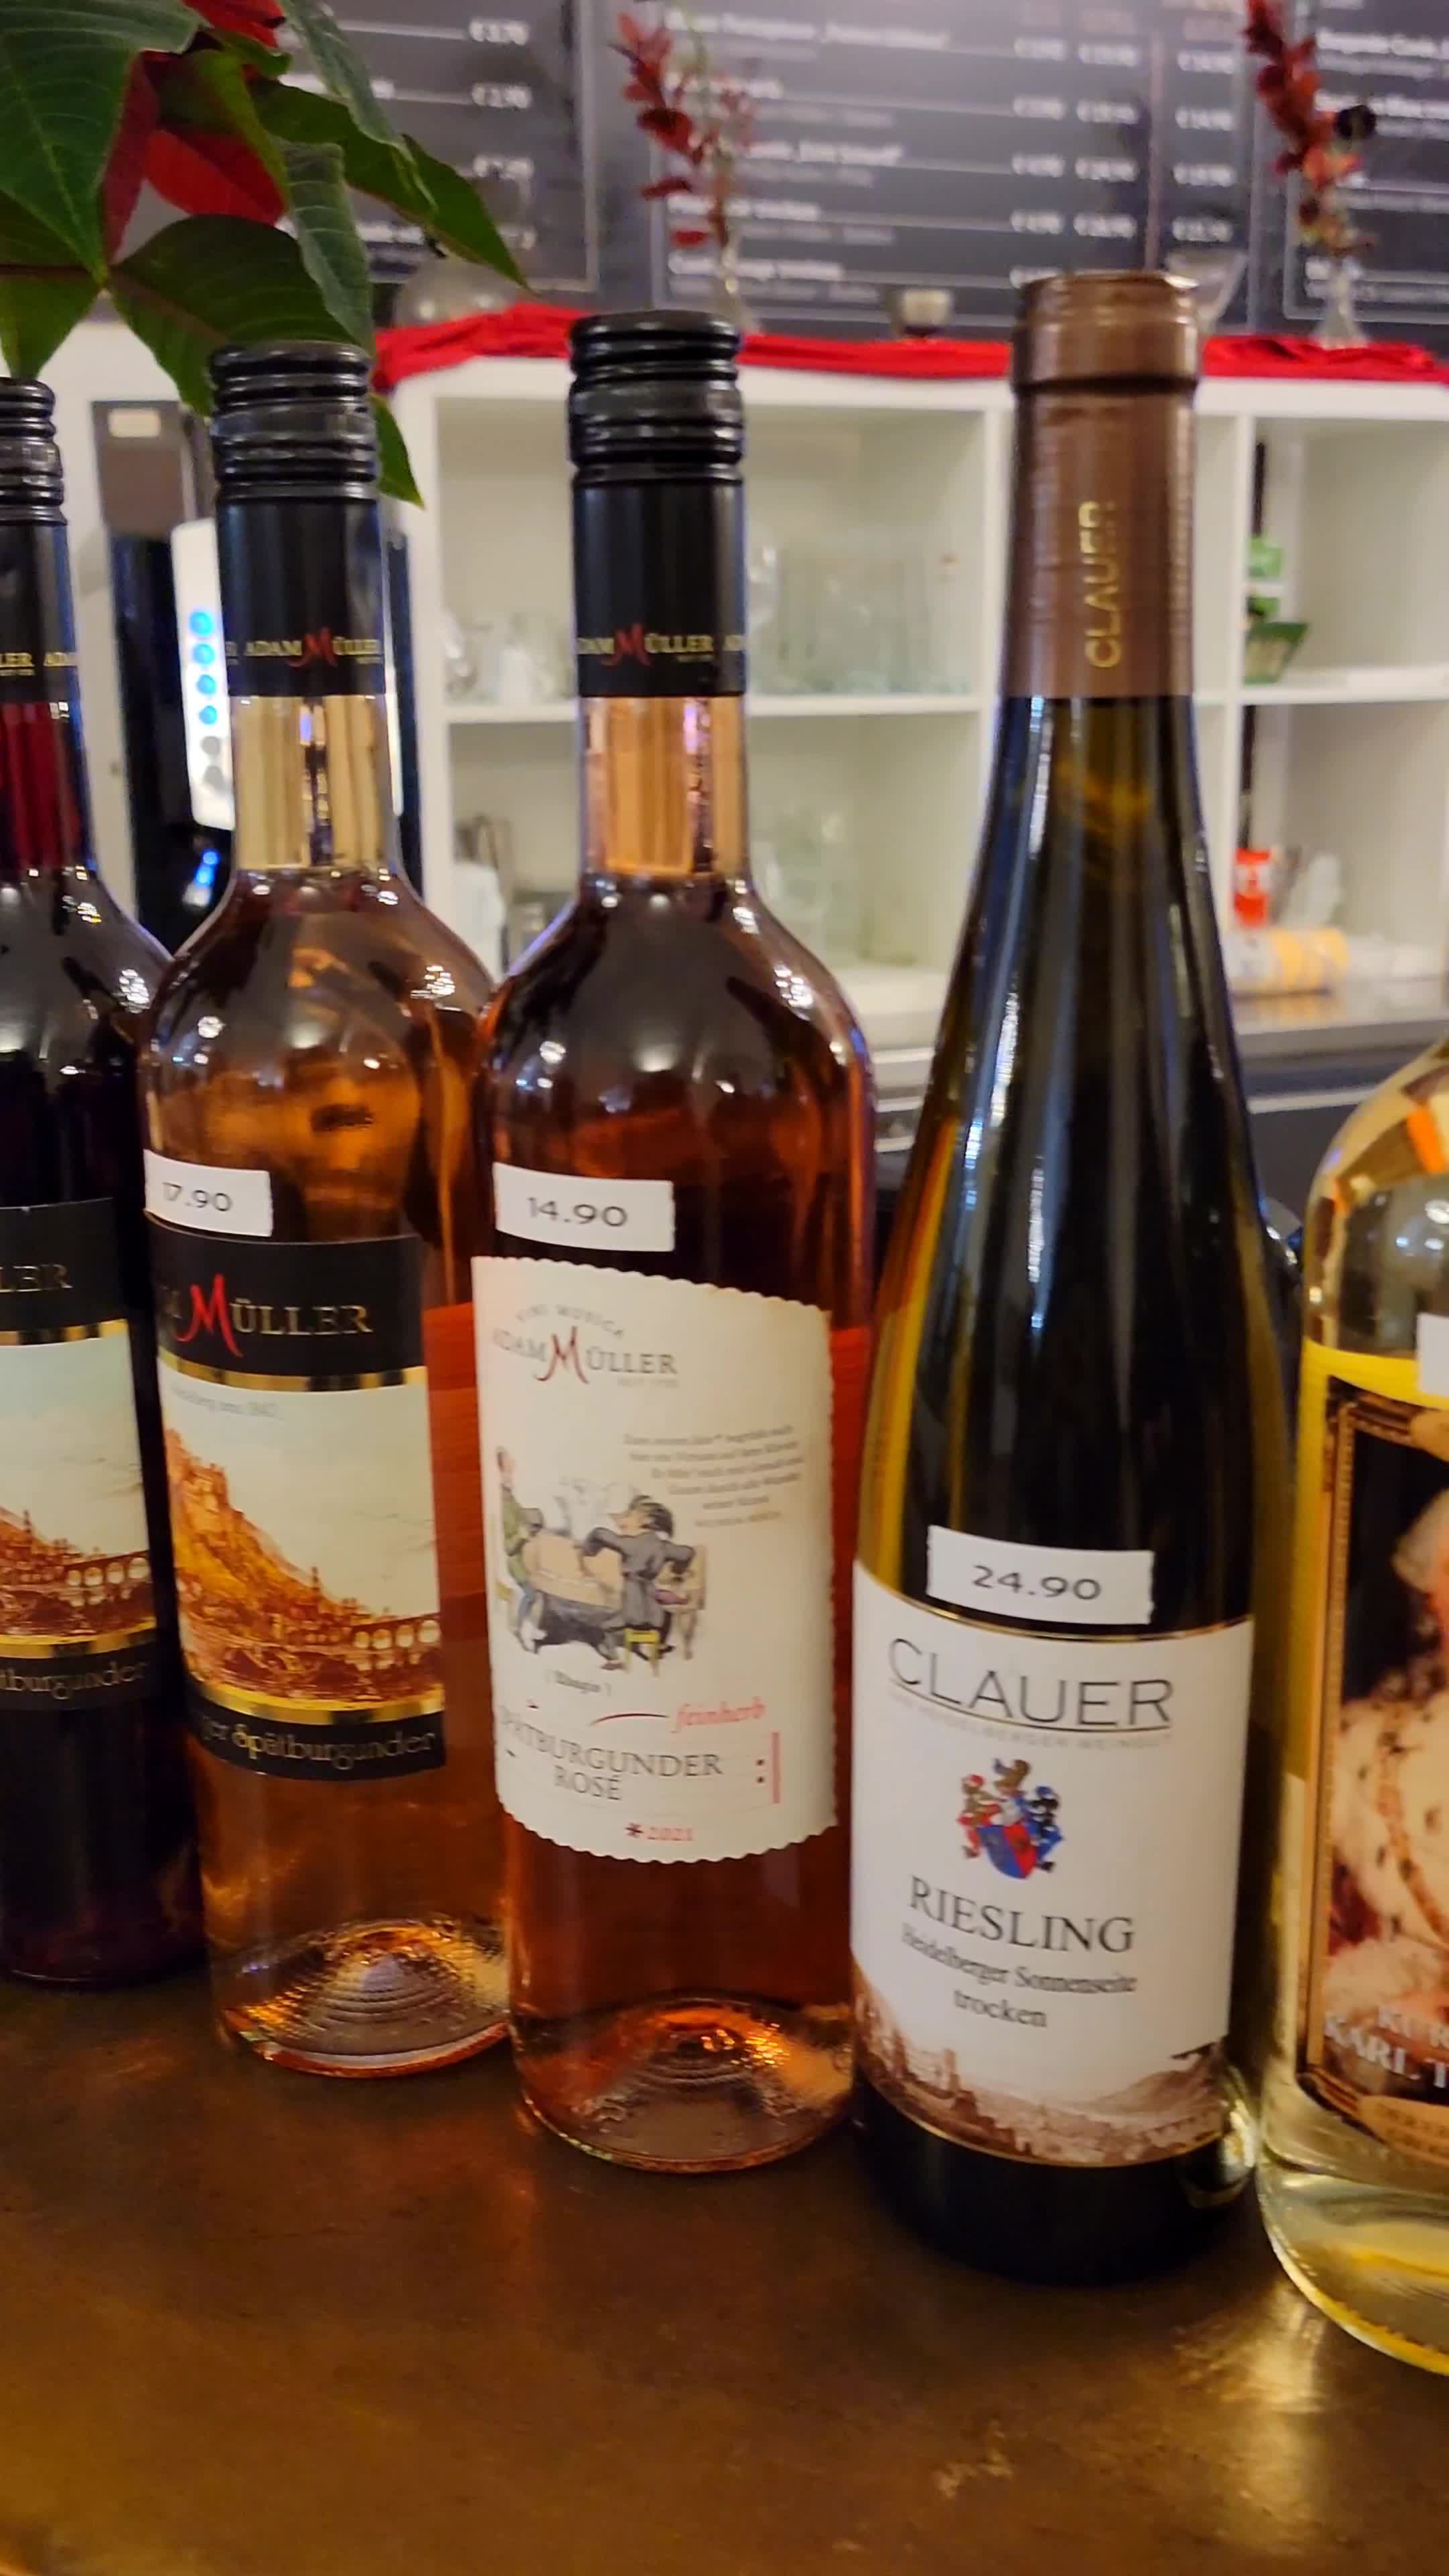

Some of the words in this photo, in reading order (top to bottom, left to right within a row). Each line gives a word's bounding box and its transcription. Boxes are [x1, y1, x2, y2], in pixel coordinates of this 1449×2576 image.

[1078, 500, 1122, 667] CLAUER
[527, 1196, 628, 1228] 14.90
[173, 1273, 374, 1358] MÜLLER
[534, 1325, 679, 1385] MÜLLER
[971, 1565, 1102, 1601] 24.90
[888, 1638, 1175, 1727] CLAUER
[553, 1765, 622, 1801] ROSÉ
[909, 1875, 1136, 1953] RIESLING
[953, 1988, 1049, 2029] trocken
[1324, 2012, 1421, 2080] KARL
